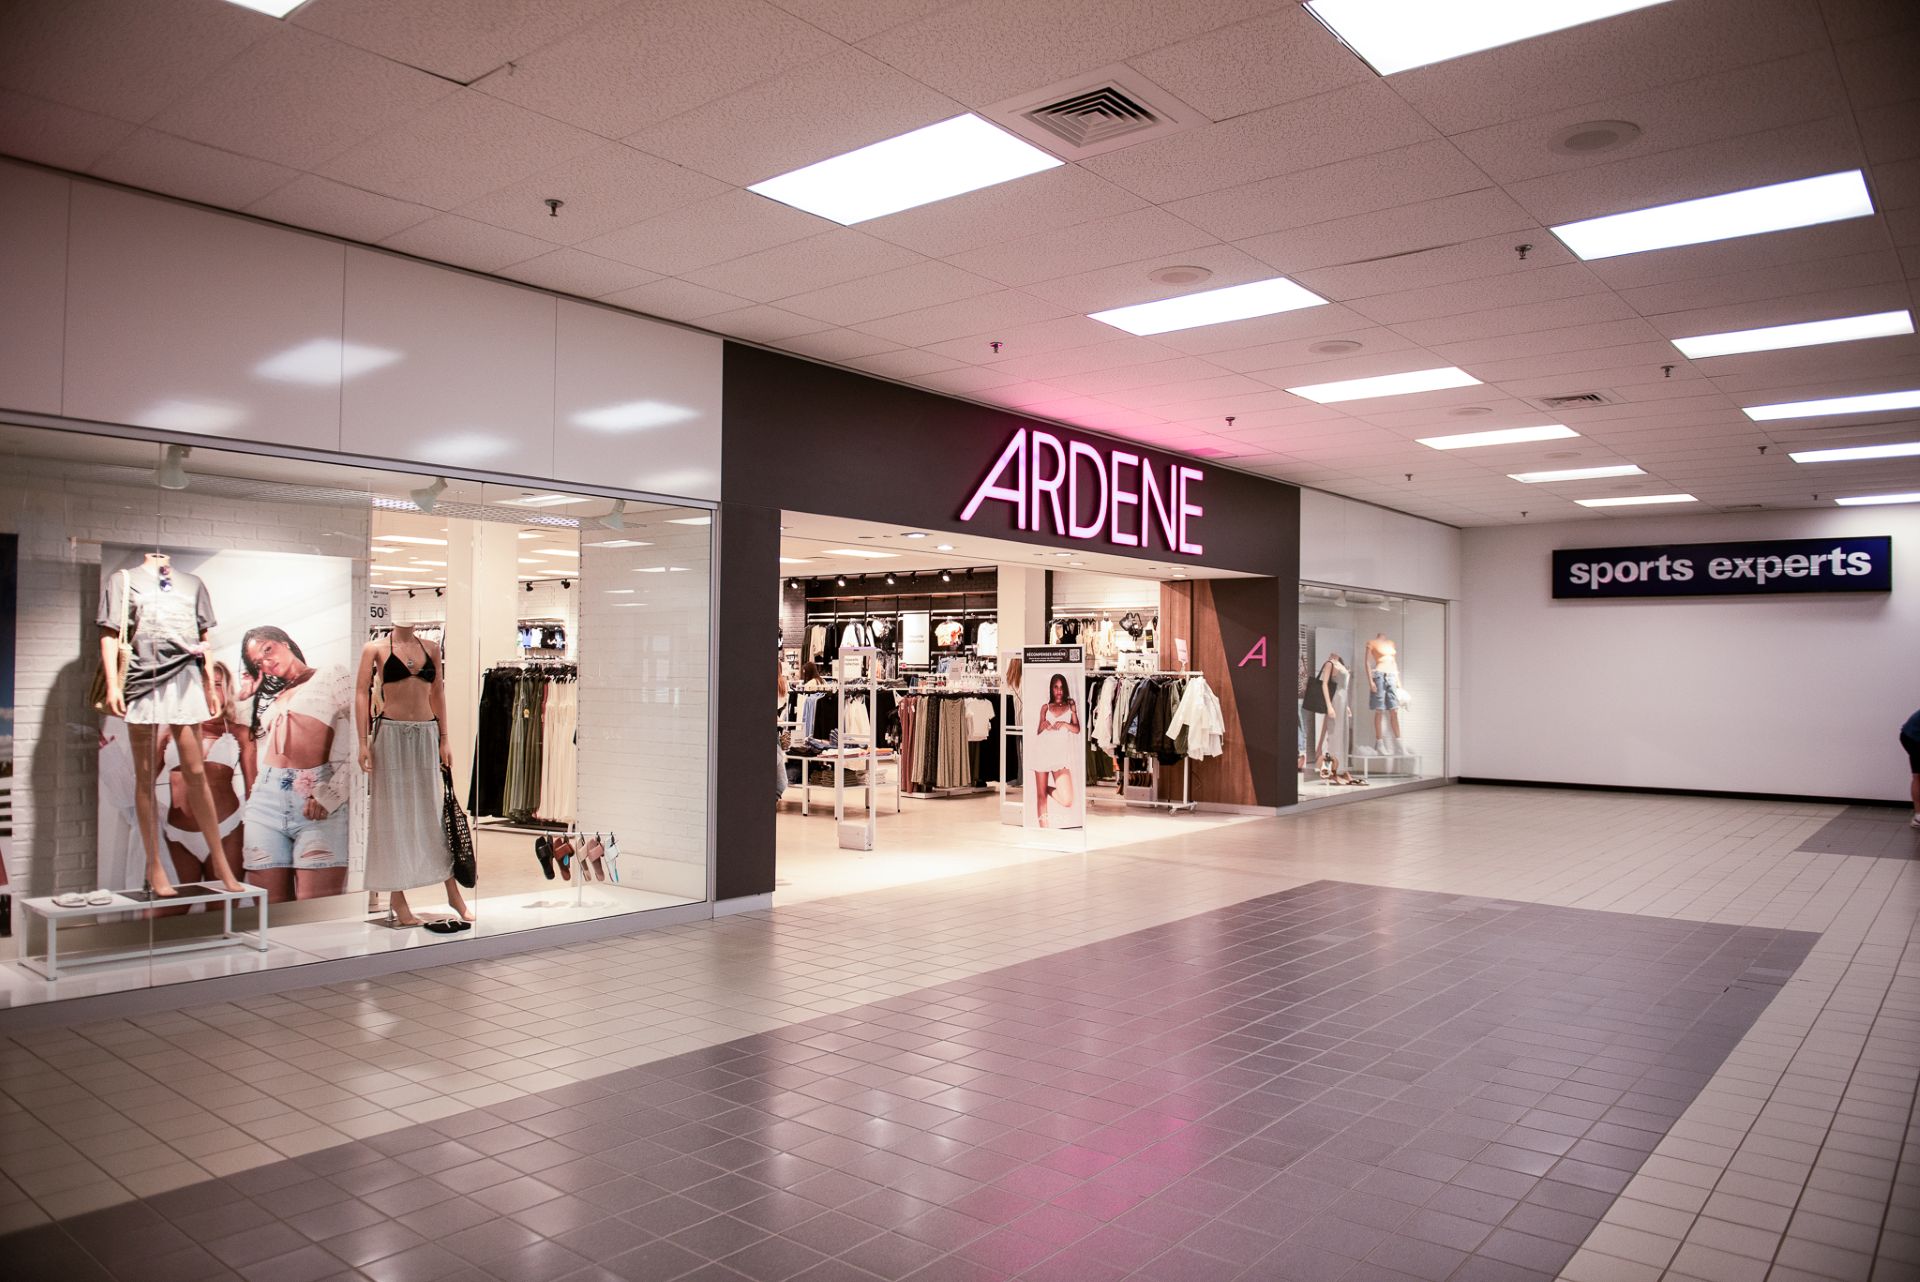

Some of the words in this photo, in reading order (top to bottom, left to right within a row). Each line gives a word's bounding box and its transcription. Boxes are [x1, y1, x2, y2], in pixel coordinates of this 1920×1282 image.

[960, 427, 1204, 556] ARDENE
[1569, 555, 1694, 590] sports
[1708, 547, 1872, 585] experts
[1238, 635, 1268, 668] A
